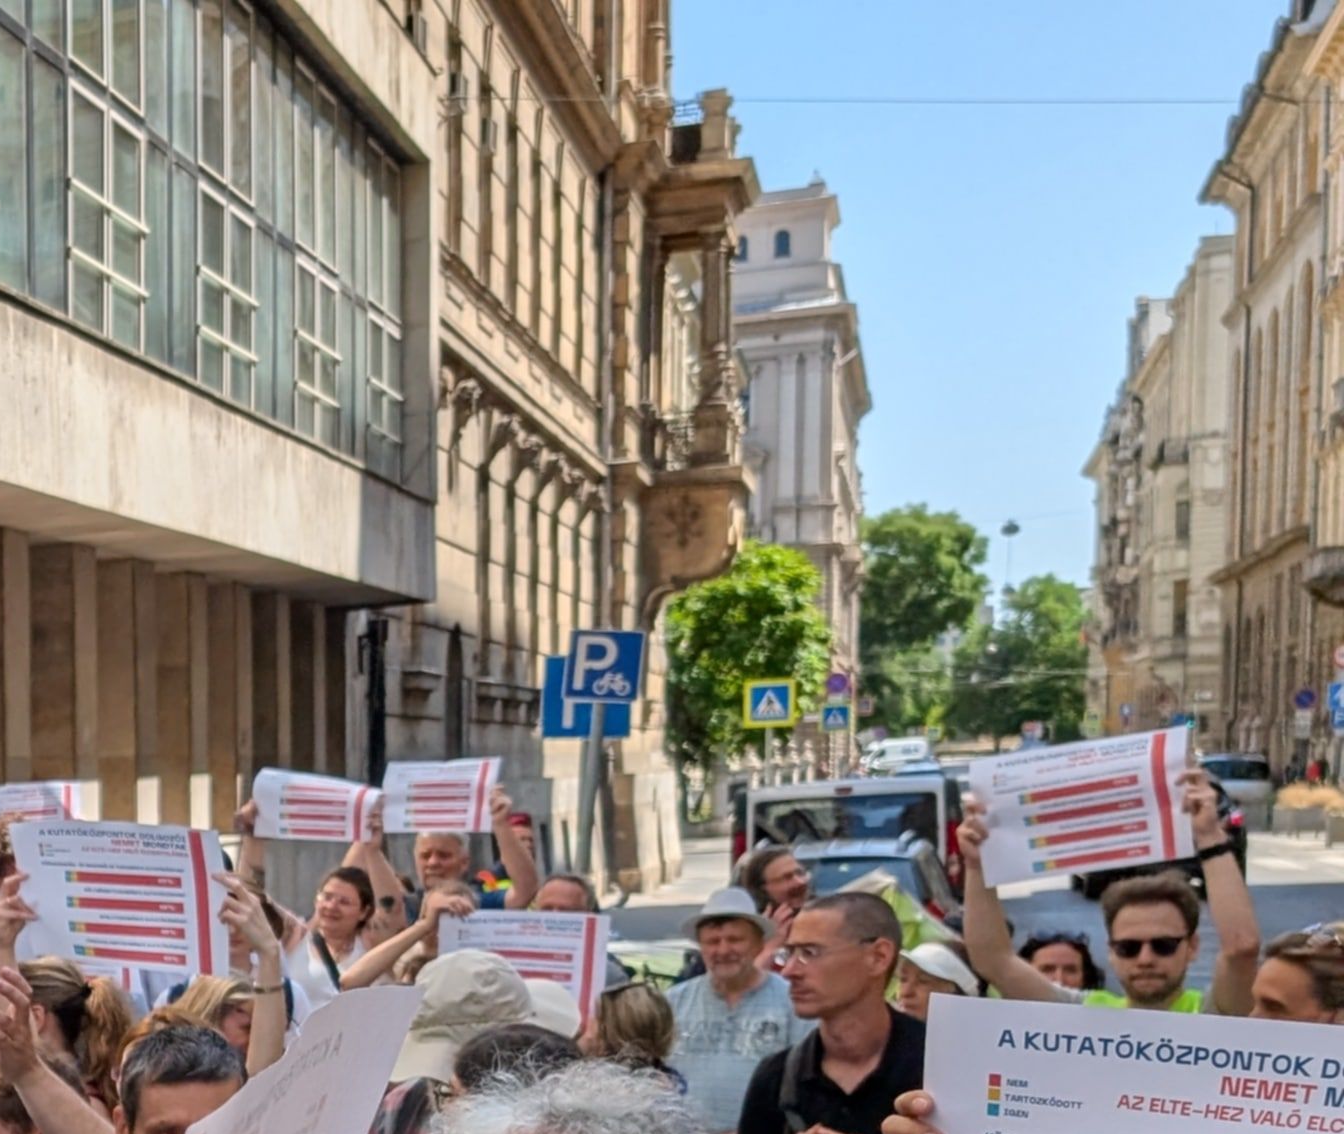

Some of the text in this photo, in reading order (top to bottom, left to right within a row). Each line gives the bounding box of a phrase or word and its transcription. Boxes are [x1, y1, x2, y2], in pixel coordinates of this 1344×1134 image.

[573, 635, 618, 690] P
[998, 1029, 1016, 1048] A
[1024, 1031, 1313, 1077] KUTATÓKÖZPONTOK
[1006, 1079, 1028, 1088] NEM
[1220, 1076, 1318, 1104] NEMET
[1003, 1108, 1029, 1119] IGEN
[1005, 1093, 1083, 1110] TARTOZKÓDOTT
[1116, 1095, 1143, 1110] AZ
[1250, 1108, 1301, 1128] VALÓ
